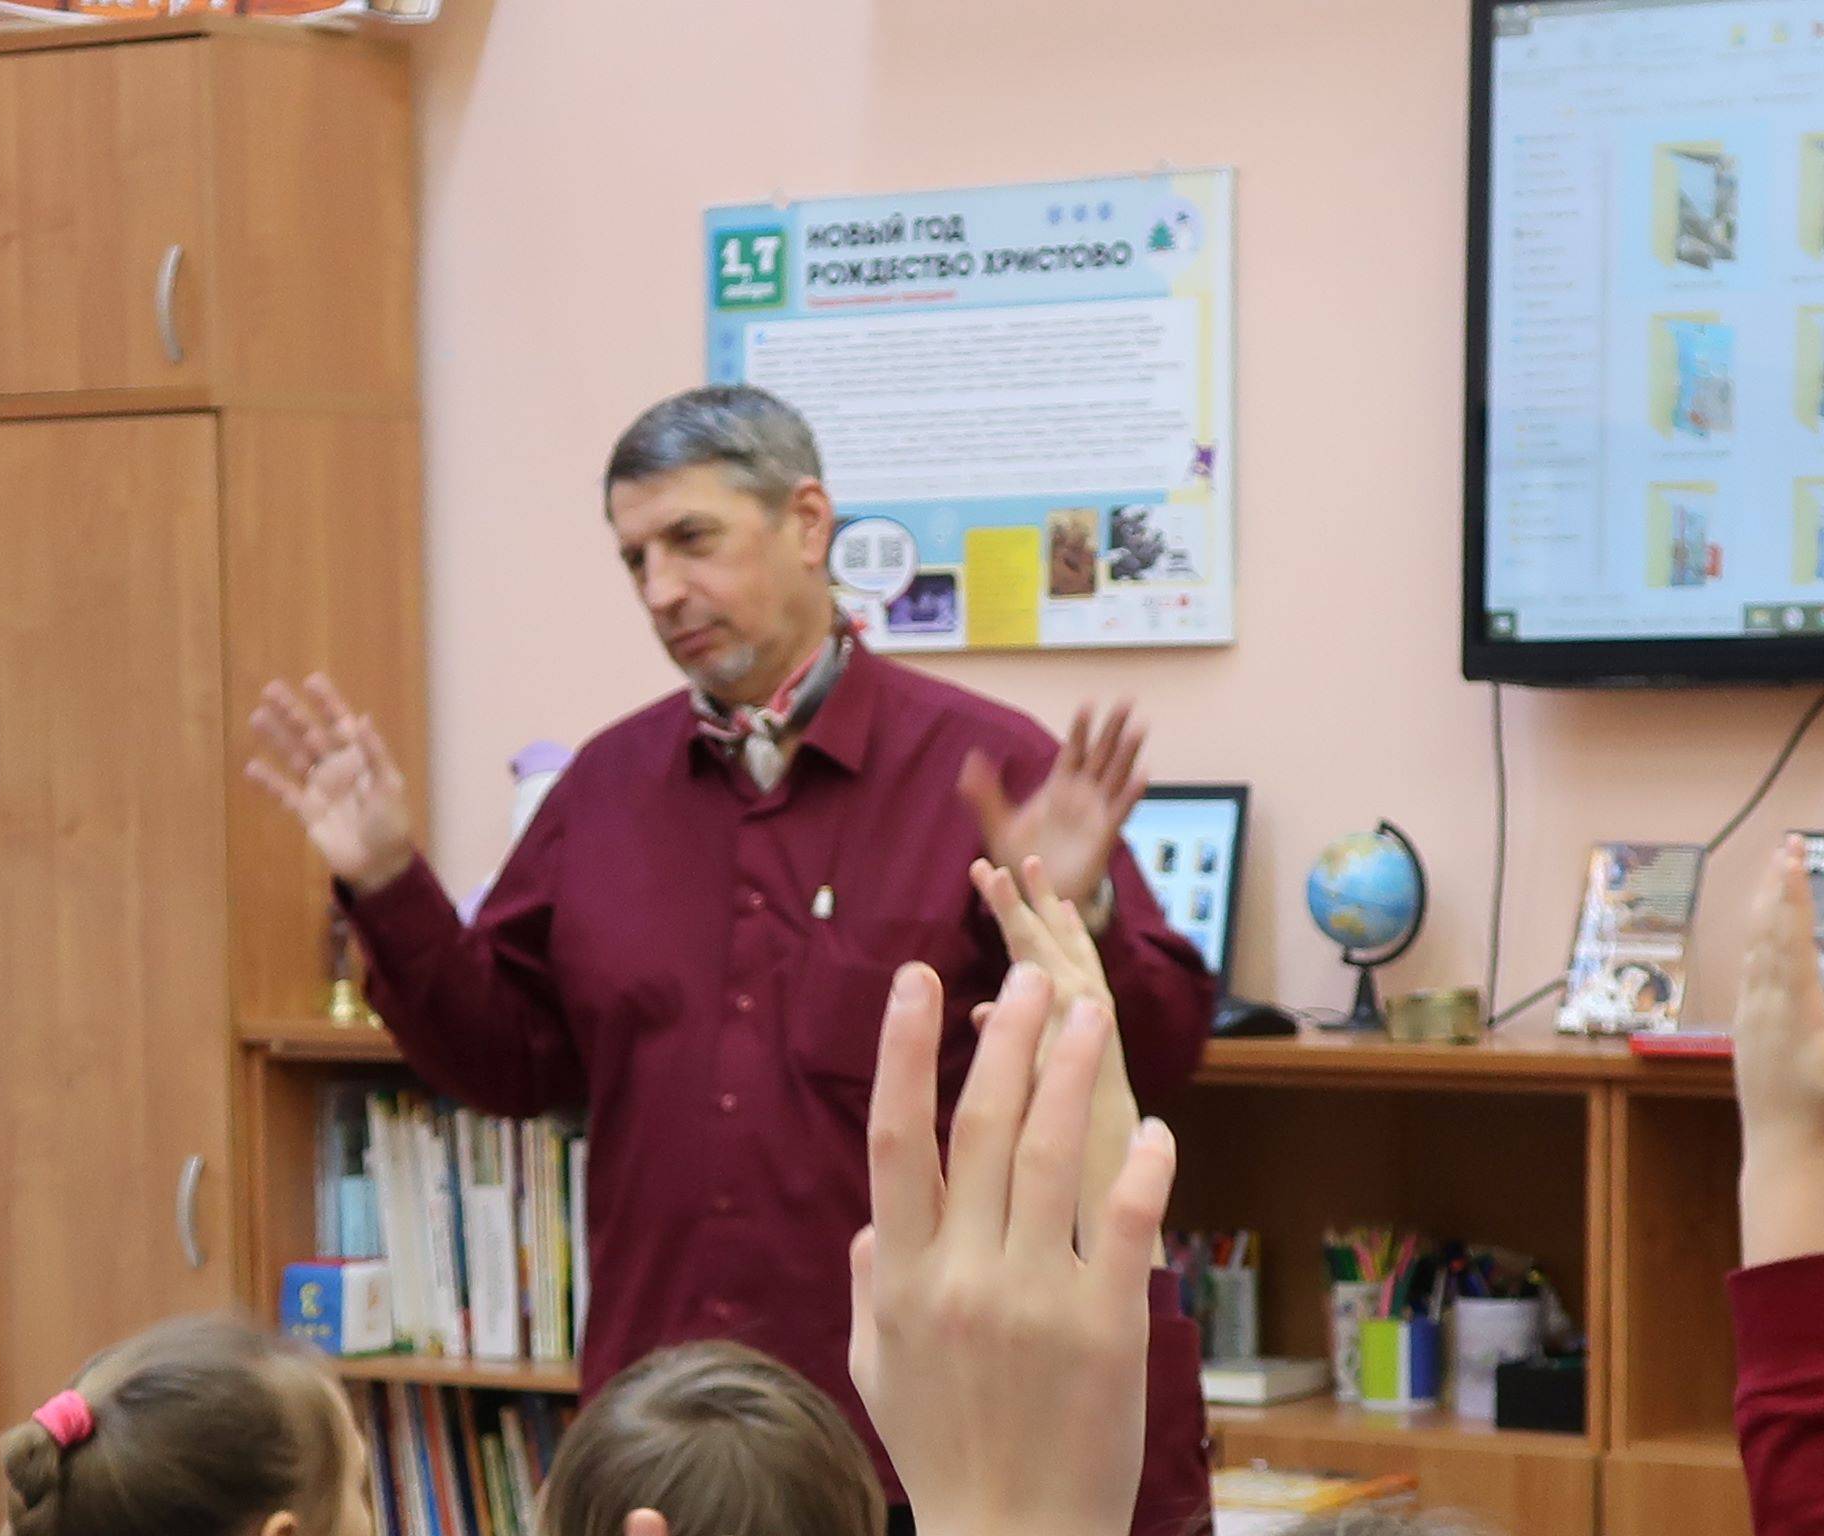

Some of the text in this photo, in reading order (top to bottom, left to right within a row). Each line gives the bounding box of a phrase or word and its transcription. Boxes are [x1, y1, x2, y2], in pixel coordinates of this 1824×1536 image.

[808, 213, 965, 248] НОВЫЙ ГОД
[807, 240, 1132, 287] РОЖДЕСТВО ХРИСТОВО
